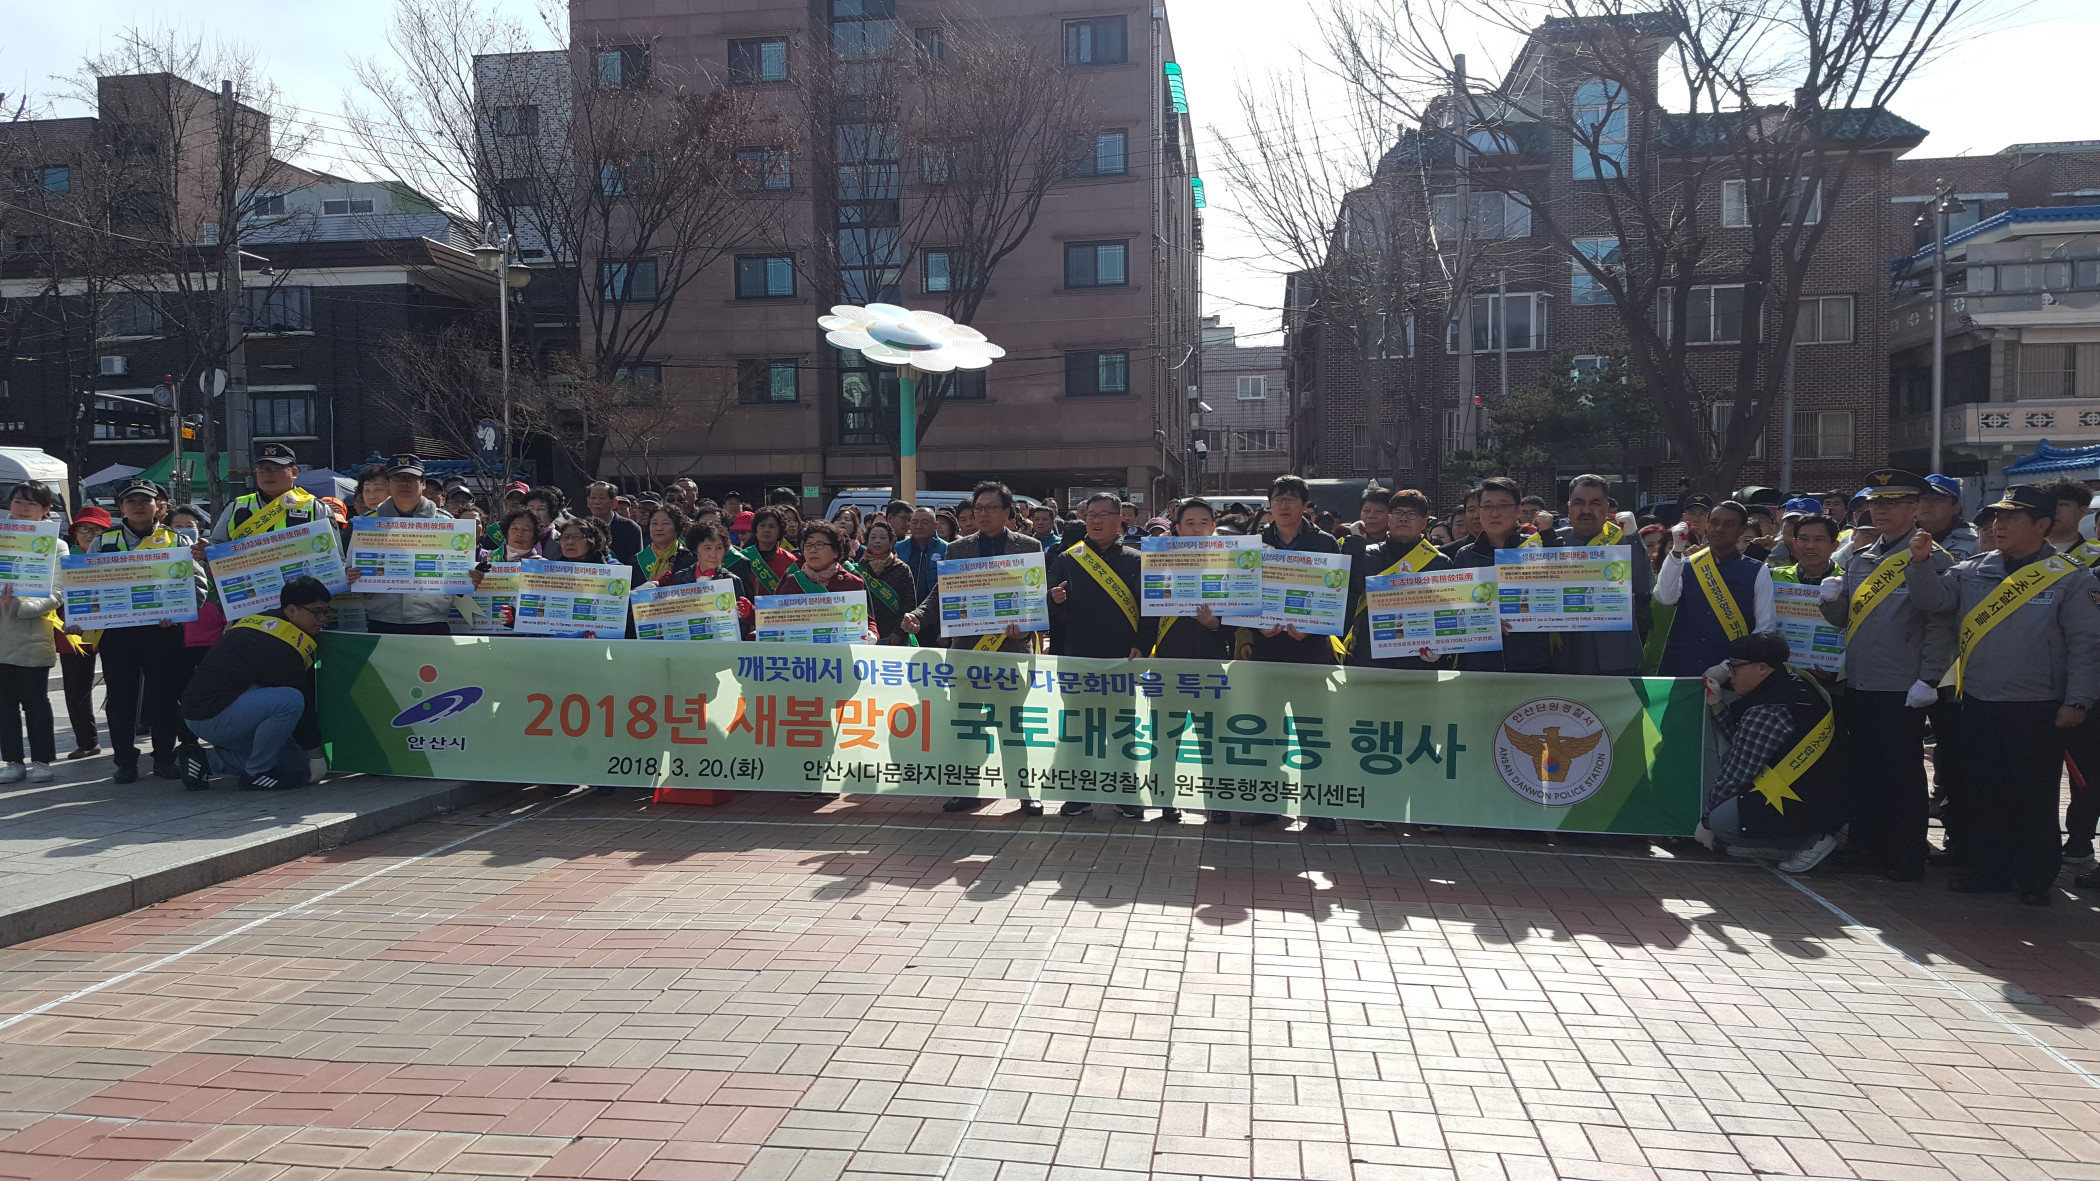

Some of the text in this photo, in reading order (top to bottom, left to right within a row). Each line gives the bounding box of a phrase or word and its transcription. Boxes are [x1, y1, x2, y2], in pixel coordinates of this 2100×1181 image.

[1225, 540, 1239, 549] 안내
[1522, 550, 1605, 561] 생활쓰레기 분리배출 안내
[598, 568, 611, 576] 안내
[1012, 558, 1025, 567] 안내
[1852, 558, 1911, 615] 기초질서를
[1974, 570, 2045, 627] 기초질서를
[738, 655, 1231, 699] 깨끗해서 아름다운 안산 다문화마을 특구
[1512, 702, 1595, 727] 안산단원경찰서
[407, 736, 466, 751] 안산시
[524, 692, 1467, 780] 2018년 새봄맞이 국토대청결운동 행사
[607, 755, 1365, 808] 2018. 3. 20.(화) 안산시다문화지원본부, 안산단원경찰서, 원곡동행정복지센터
[1500, 746, 1606, 800] ANSAN DANWON POLICE STATION
